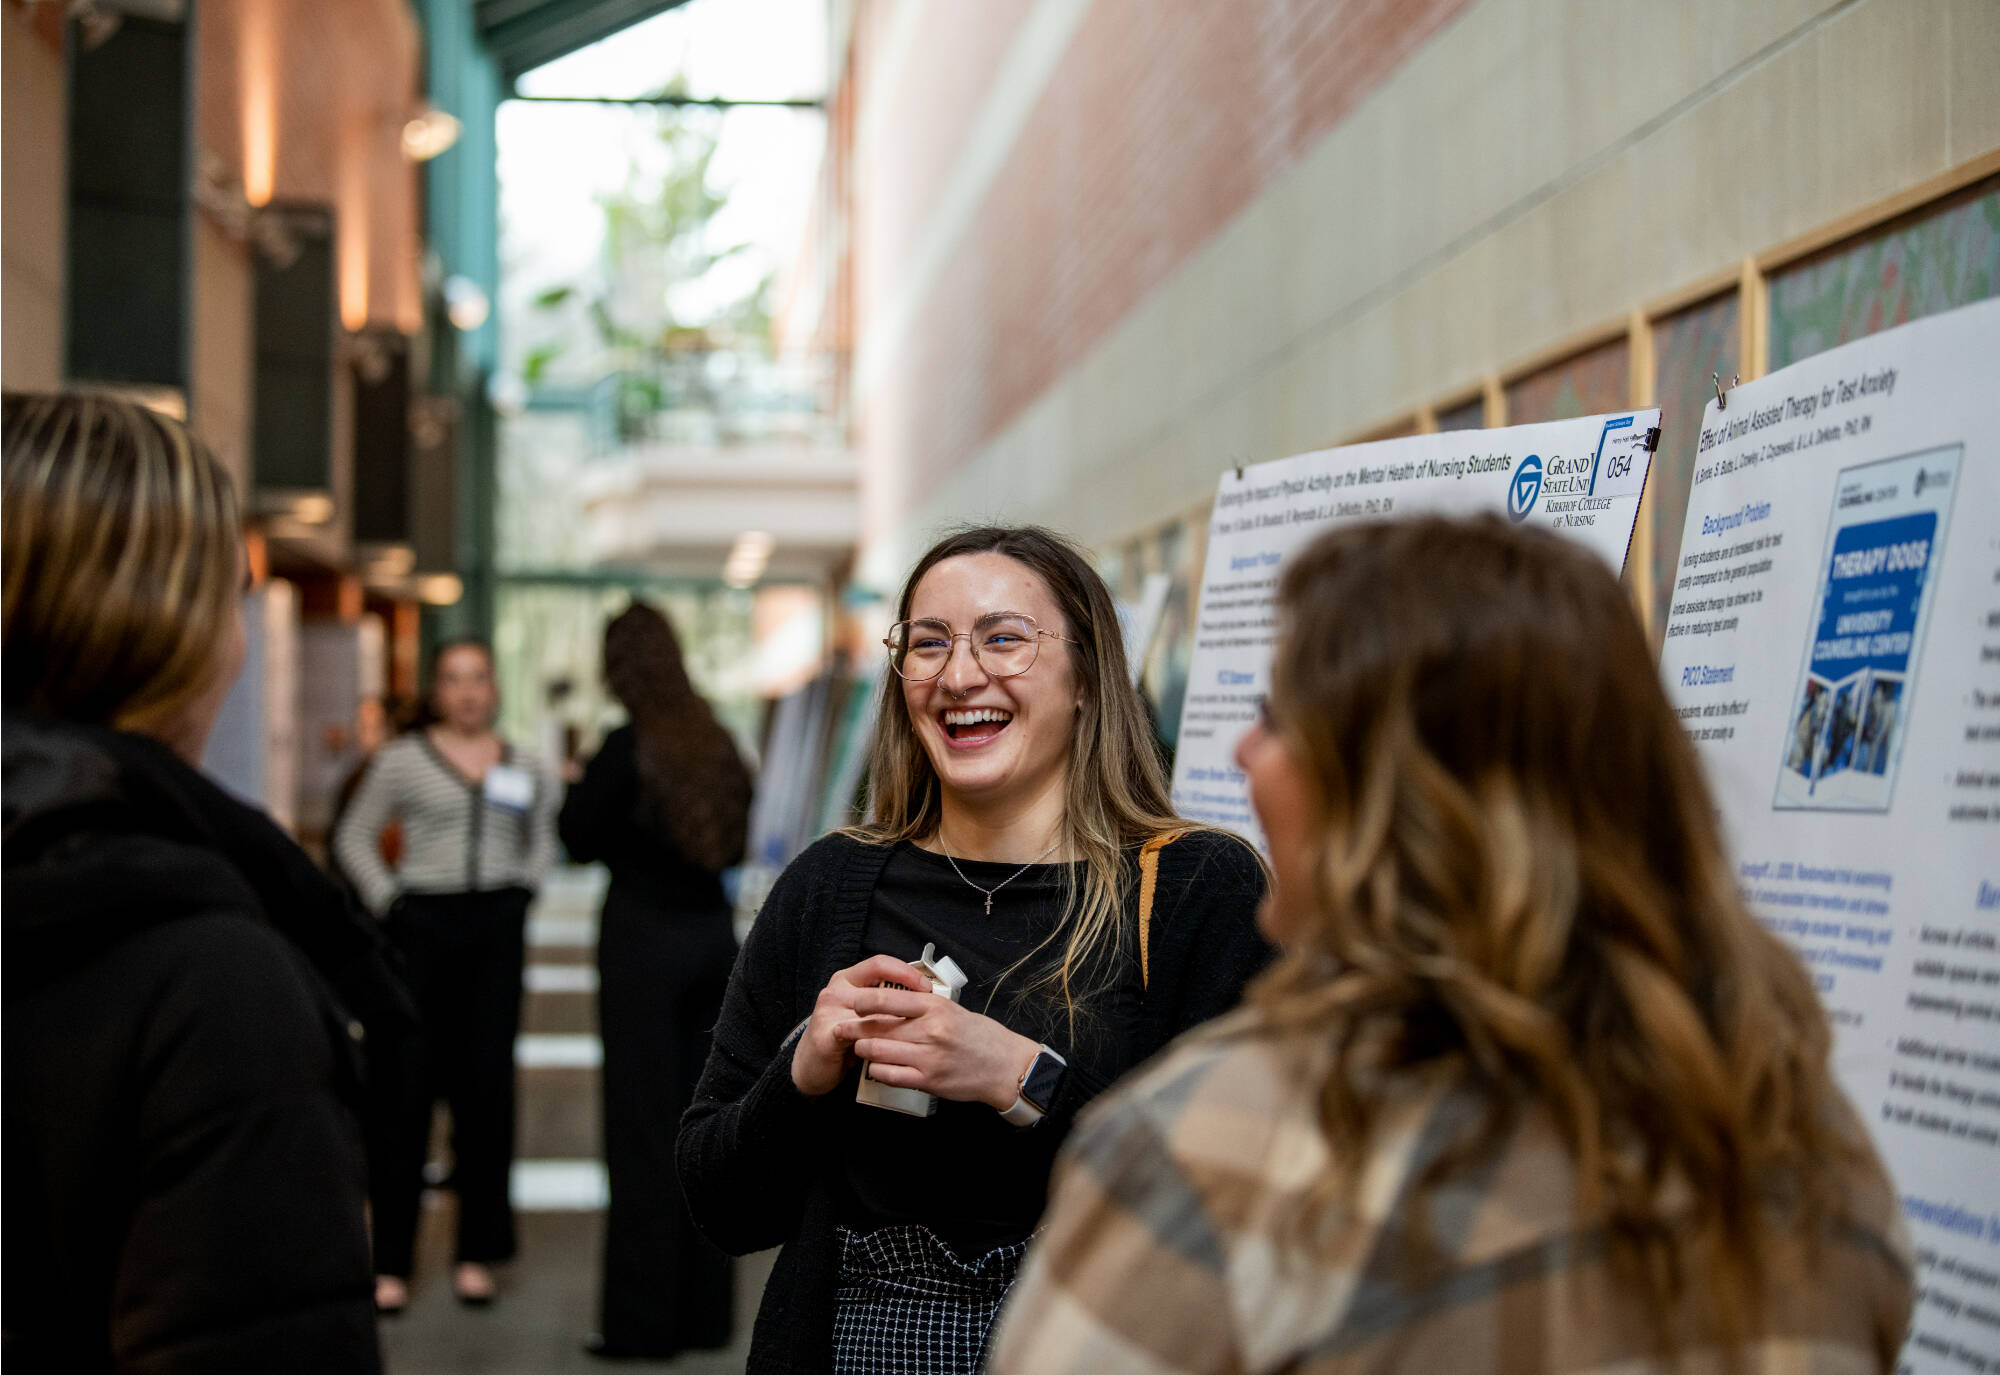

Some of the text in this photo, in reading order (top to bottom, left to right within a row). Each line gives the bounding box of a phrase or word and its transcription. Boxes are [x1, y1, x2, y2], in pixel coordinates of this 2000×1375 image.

[1700, 367, 1898, 453] Effect of Animal Assisted Therapy for Test Anxiety
[1358, 464, 1387, 485] Mental
[1387, 460, 1415, 482] Health
[1416, 459, 1428, 479] of
[1427, 456, 1466, 480] Nursing
[1466, 453, 1512, 474] Students
[1607, 454, 1633, 479] 054
[1702, 501, 1772, 537] Background Problem
[1832, 538, 1929, 580] THERAPY DOGS
